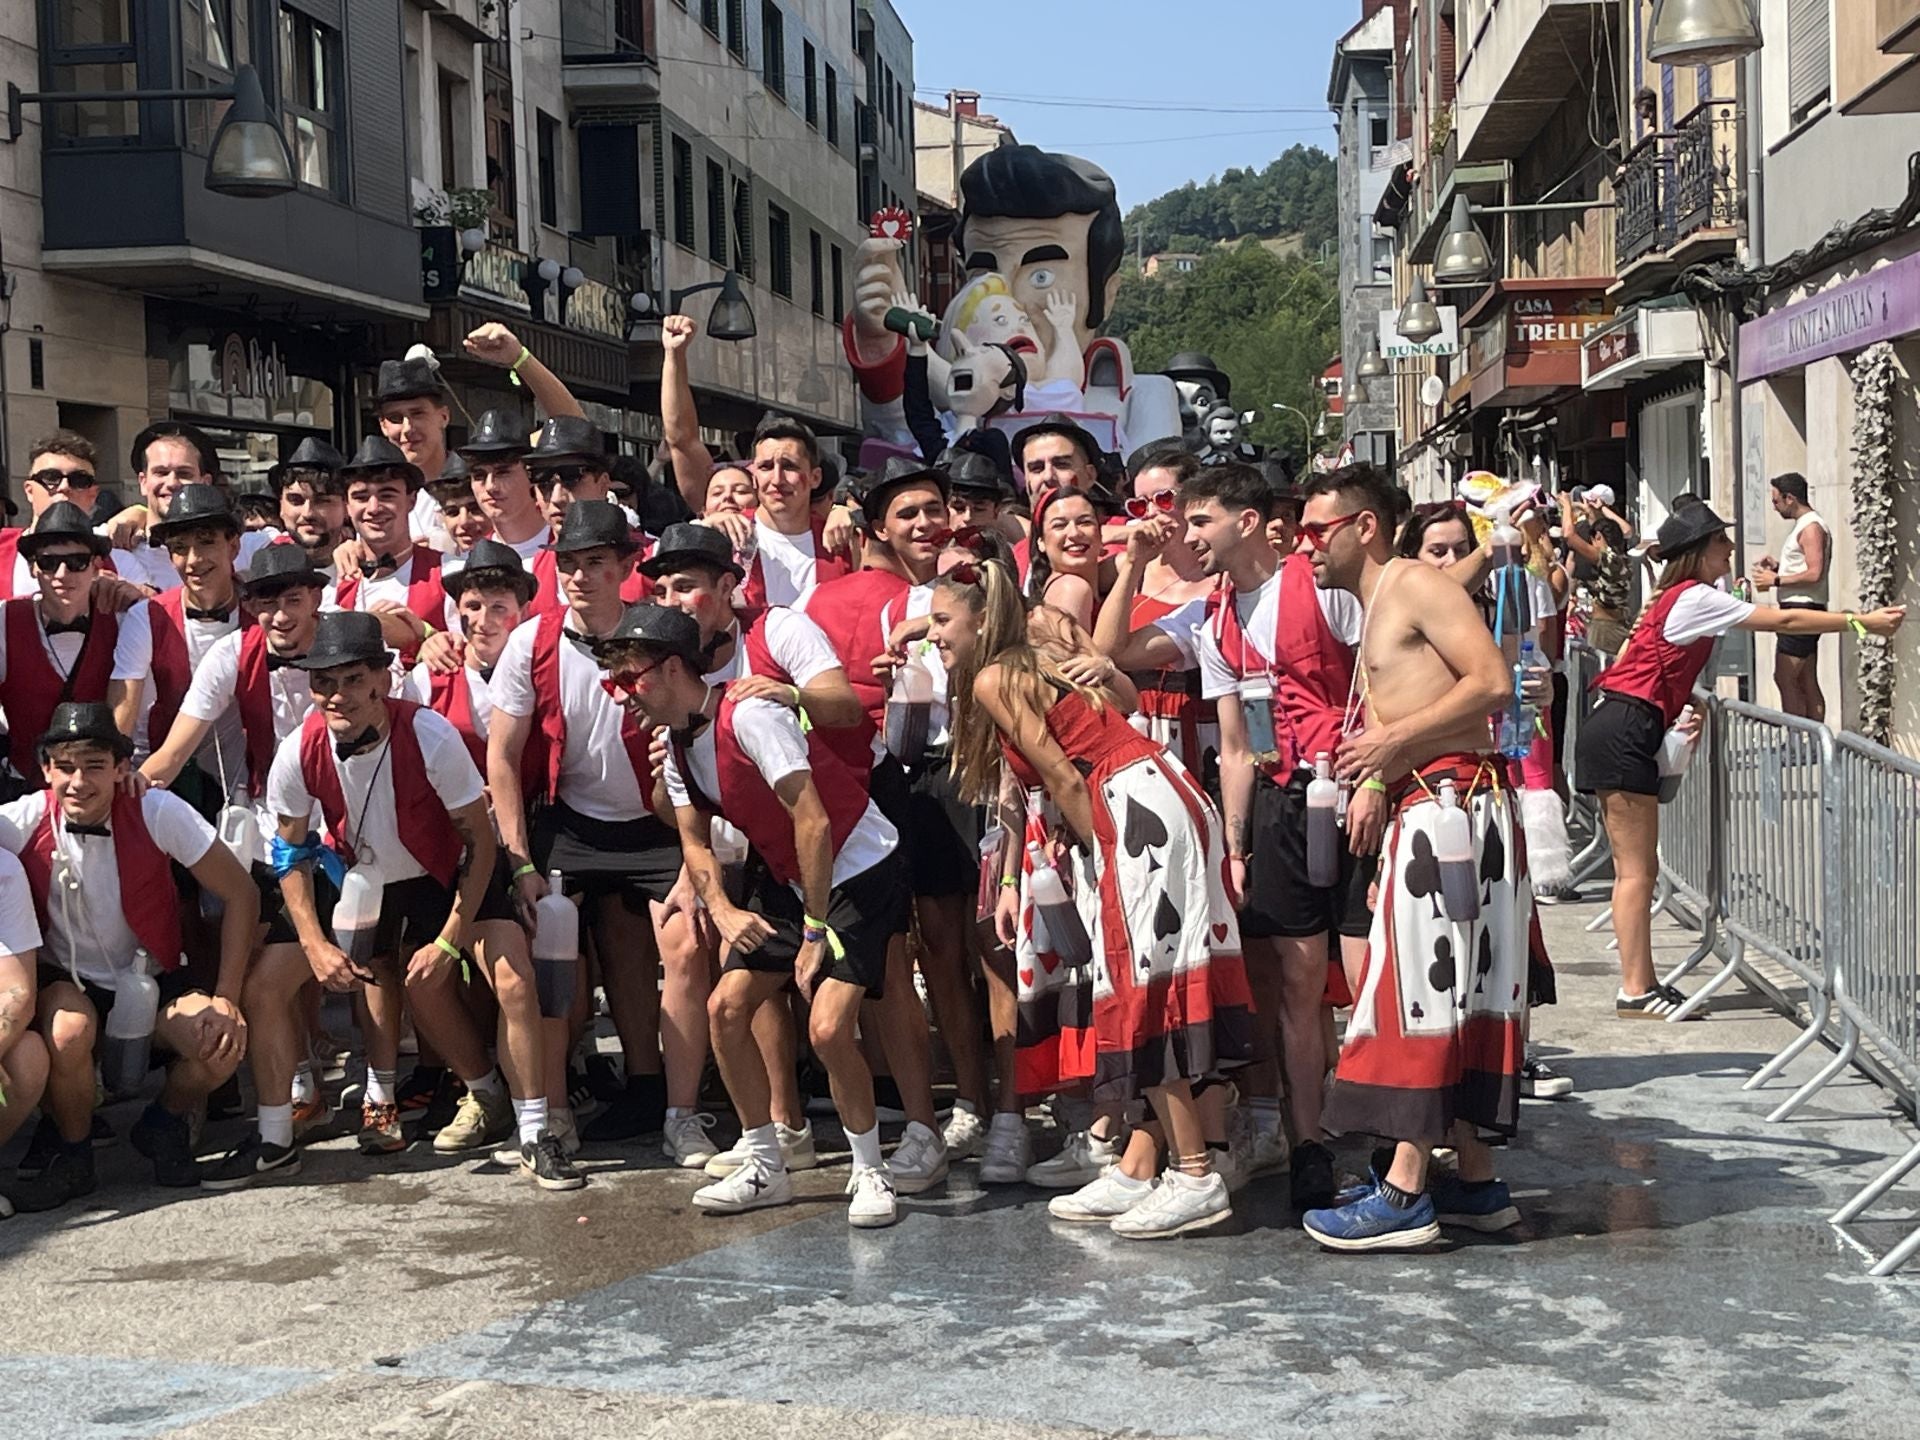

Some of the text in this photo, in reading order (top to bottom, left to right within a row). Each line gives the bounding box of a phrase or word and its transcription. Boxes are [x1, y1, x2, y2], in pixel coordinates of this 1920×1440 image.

[1514, 299, 1553, 314] CASA
[1832, 284, 1873, 338] MONAS
[1387, 342, 1453, 357] BUNKAI
